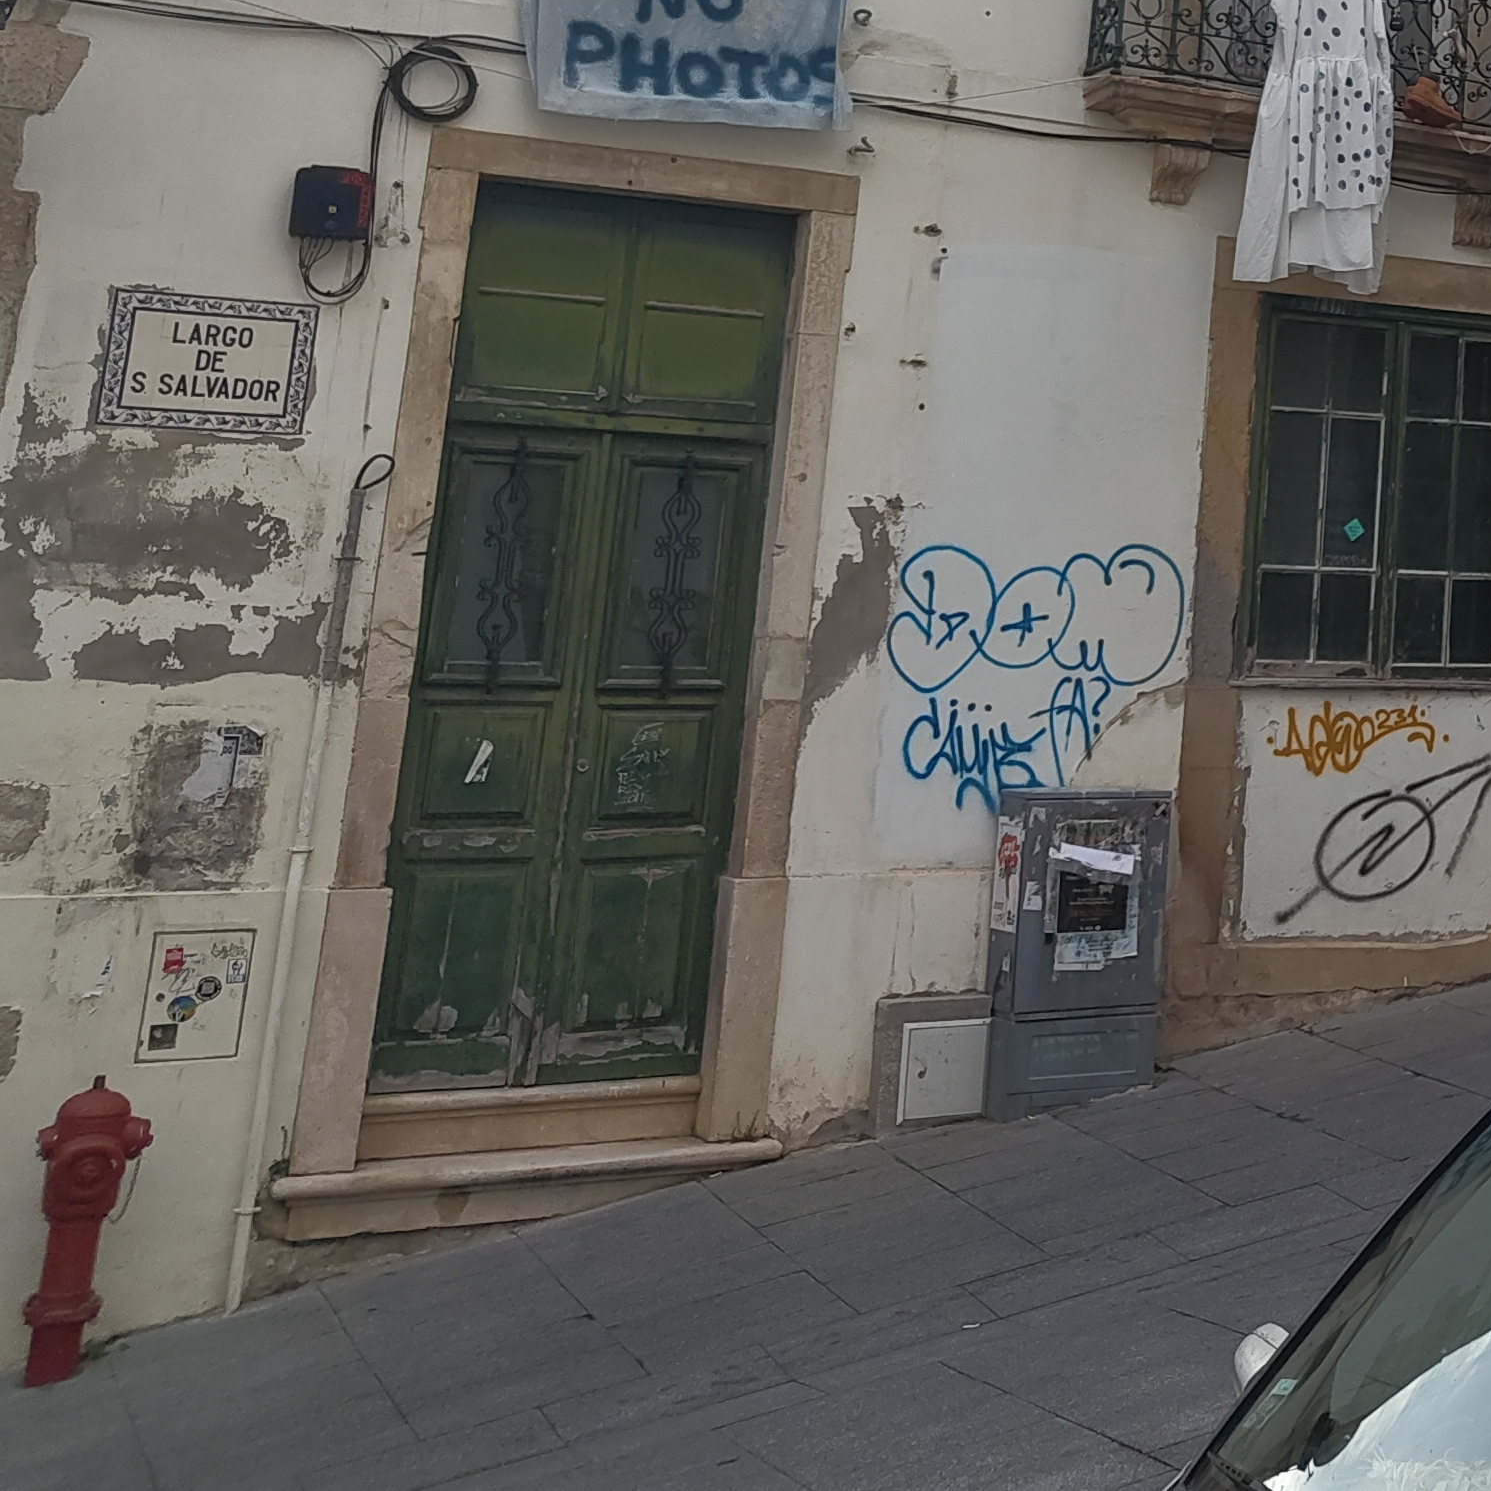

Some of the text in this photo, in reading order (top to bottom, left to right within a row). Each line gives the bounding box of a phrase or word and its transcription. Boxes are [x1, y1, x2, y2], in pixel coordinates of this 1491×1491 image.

[171, 321, 254, 349] LARGO
[194, 349, 228, 373] DE
[157, 373, 281, 403] SALVADOR
